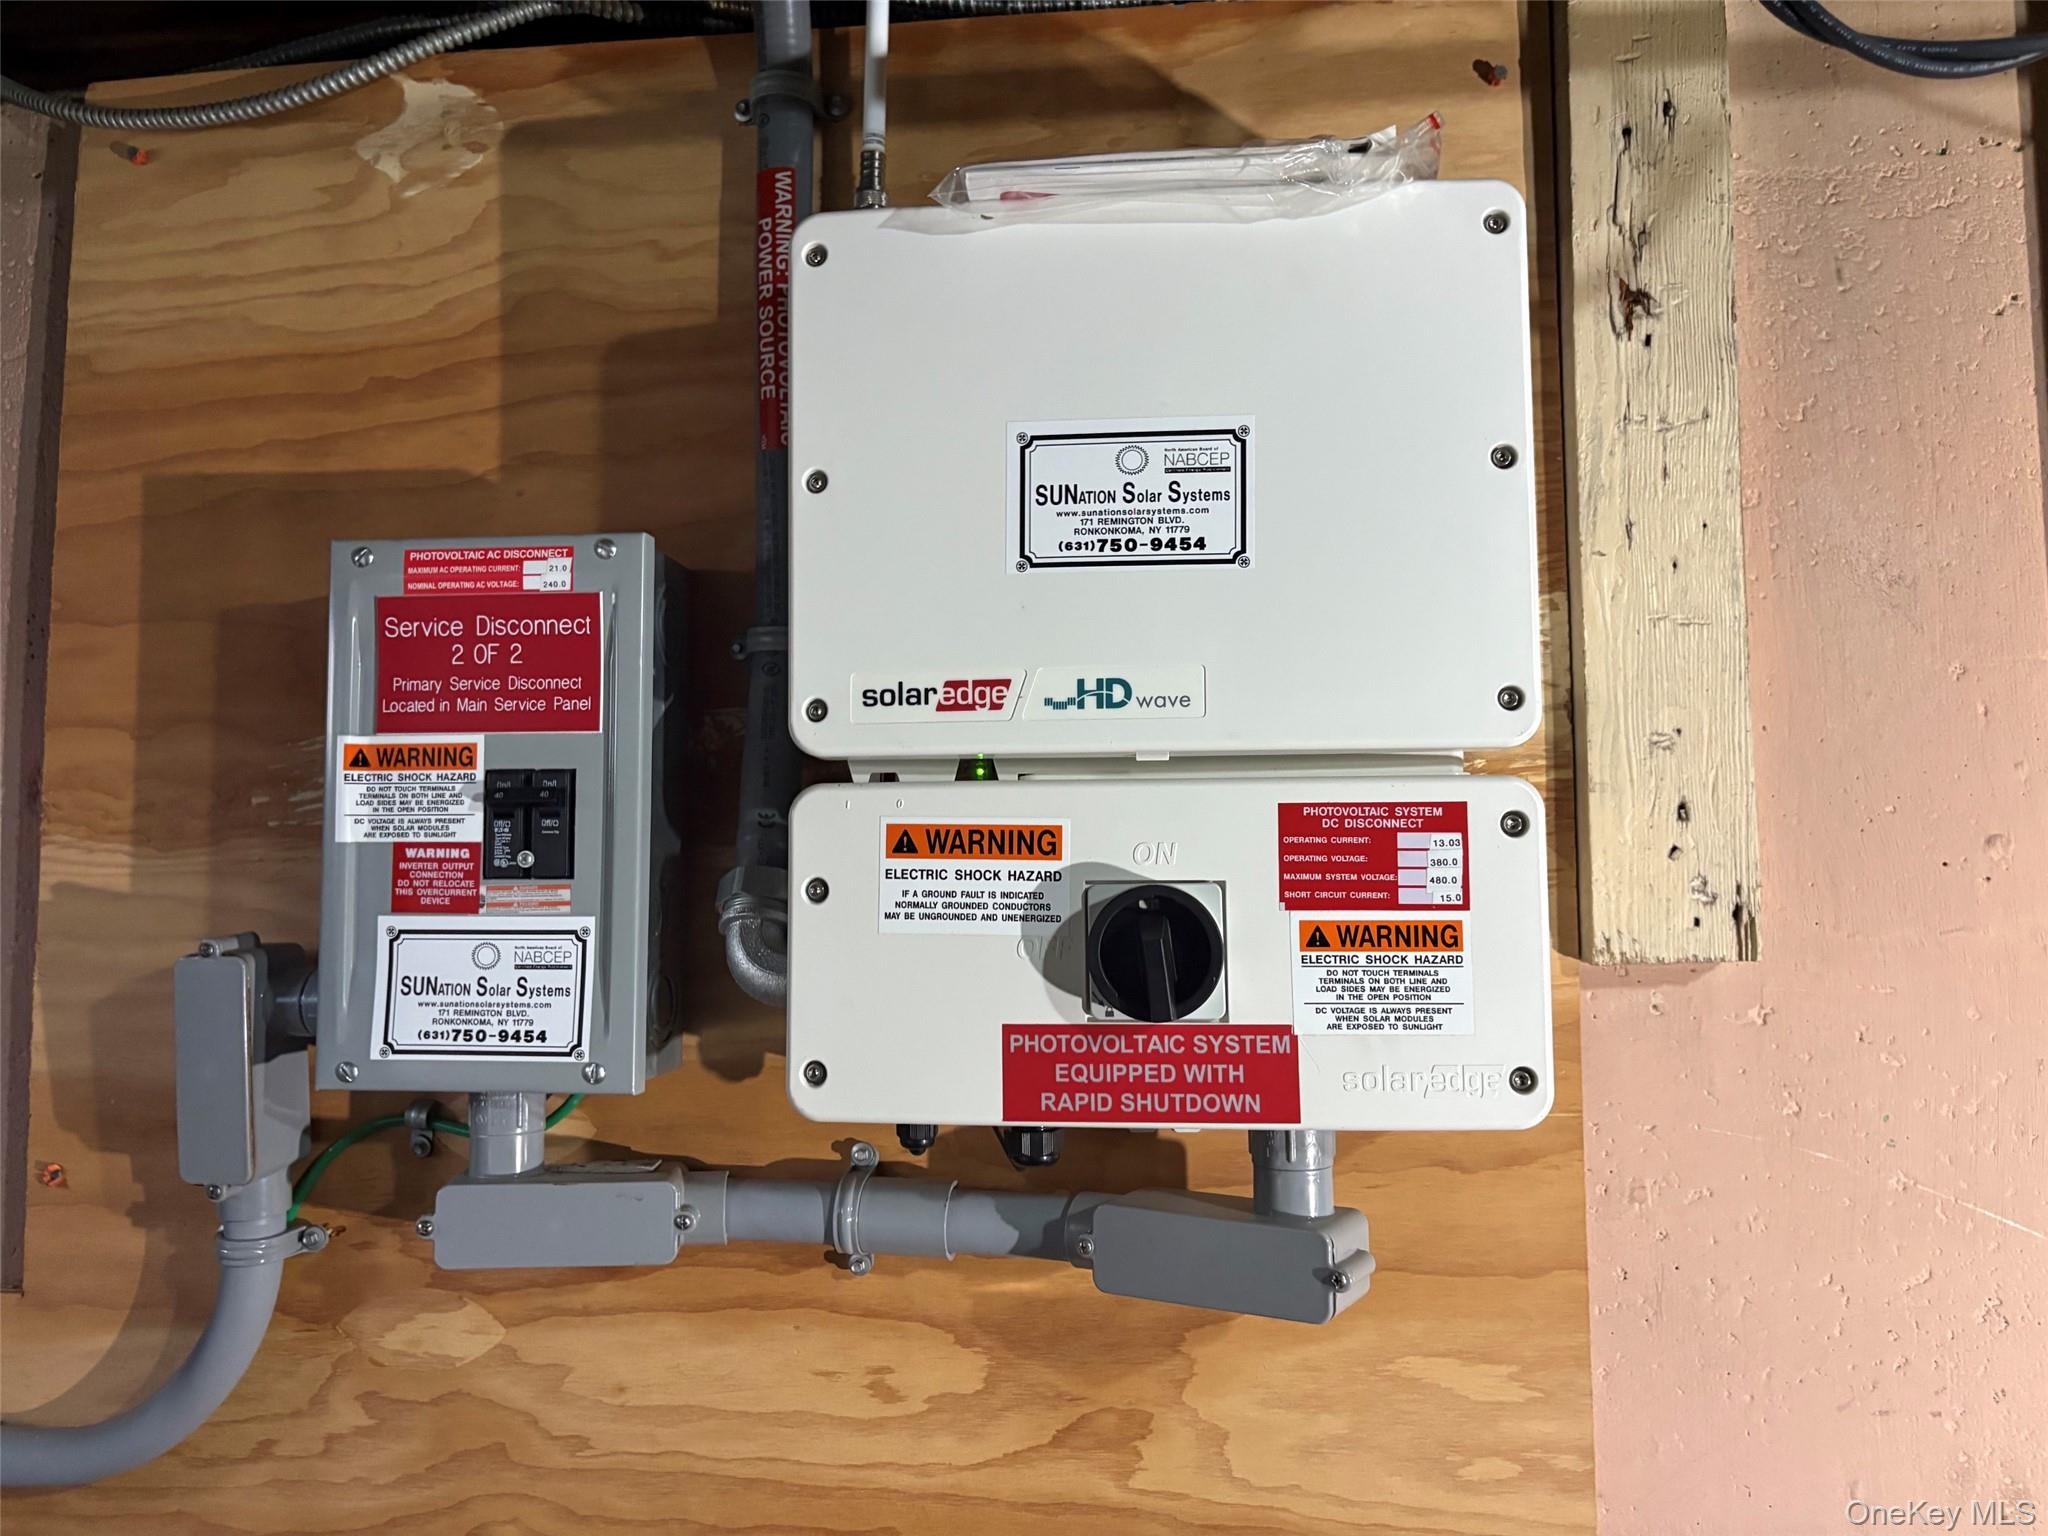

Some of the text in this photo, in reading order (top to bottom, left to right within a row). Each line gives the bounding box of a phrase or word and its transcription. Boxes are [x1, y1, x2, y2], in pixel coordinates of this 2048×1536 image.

[774, 171, 792, 276] WARNING:
[758, 217, 776, 399] POWER SOURCE
[1164, 452, 1230, 466] NABCEP
[1122, 482, 1162, 504] Solar
[1168, 480, 1231, 504] Systems
[1056, 506, 1209, 517] www.sunationsolarsystems.com
[1080, 516, 1184, 526] 171 REMINGTON BLVD.
[1074, 526, 1190, 536] RONKONKOMA, NY 11779
[1059, 537, 1206, 553] (631)750-9454
[410, 549, 568, 561] PHOTOVOLTAIC AC DISCONNECT
[384, 615, 591, 638] Service Disconnect
[452, 643, 522, 665] 2 OF 2
[393, 676, 582, 693] Primary Service Disconnect
[862, 681, 1008, 711] solaredge
[1077, 678, 1191, 709] HD wave
[382, 696, 591, 713] Located in Main Service Panel
[376, 746, 473, 768] WARNING
[344, 773, 476, 781] ELECTRIC SHOCK HAZARD
[1304, 807, 1442, 816] PHOTOVOLTAIC SYSTEM
[1322, 819, 1423, 828] DC DISCONNECT
[925, 829, 1056, 856] WARNING
[1433, 839, 1460, 847] 13.03
[405, 848, 470, 859] WARNING
[1133, 841, 1177, 865] ON
[400, 862, 474, 870] INVERTER OUTPUT
[1430, 858, 1457, 866] 380.0
[885, 869, 1062, 882] ELECTRIC SHOCK HAZARD
[1430, 876, 1457, 884] 480.0
[395, 888, 477, 896] THIS OVERCURRENT
[902, 890, 1044, 900] IF A GROUND FAULT IS INDICATED
[1350, 891, 1390, 899] CURRENT:
[1440, 894, 1461, 902] 15.0
[895, 901, 1051, 911] NORMALLY GROUNDED CONDUCTORS
[884, 912, 900, 920] MAY
[919, 913, 977, 921] UNGROUNDED
[1002, 914, 1061, 923] UNENERGIZED
[1336, 924, 1458, 948] WARNING
[514, 951, 572, 963] NABCEP
[1301, 955, 1463, 964] ELECTRIC SHOCK HAZARD
[477, 976, 511, 997] Solar
[516, 976, 571, 999] Systems
[418, 1000, 552, 1009] www.sunationsolarsystems.com
[432, 1018, 534, 1026] RONKONKOMA, NY 11779
[418, 1029, 547, 1043] (631)750-9454
[1010, 1035, 1290, 1054] PHOTOVOLTAIC SYSTEM
[1055, 1064, 1244, 1083] EQUIPPED WITH
[1342, 1065, 1502, 1098] solaredge
[1040, 1092, 1261, 1112] RAPID SHUTDOWN
